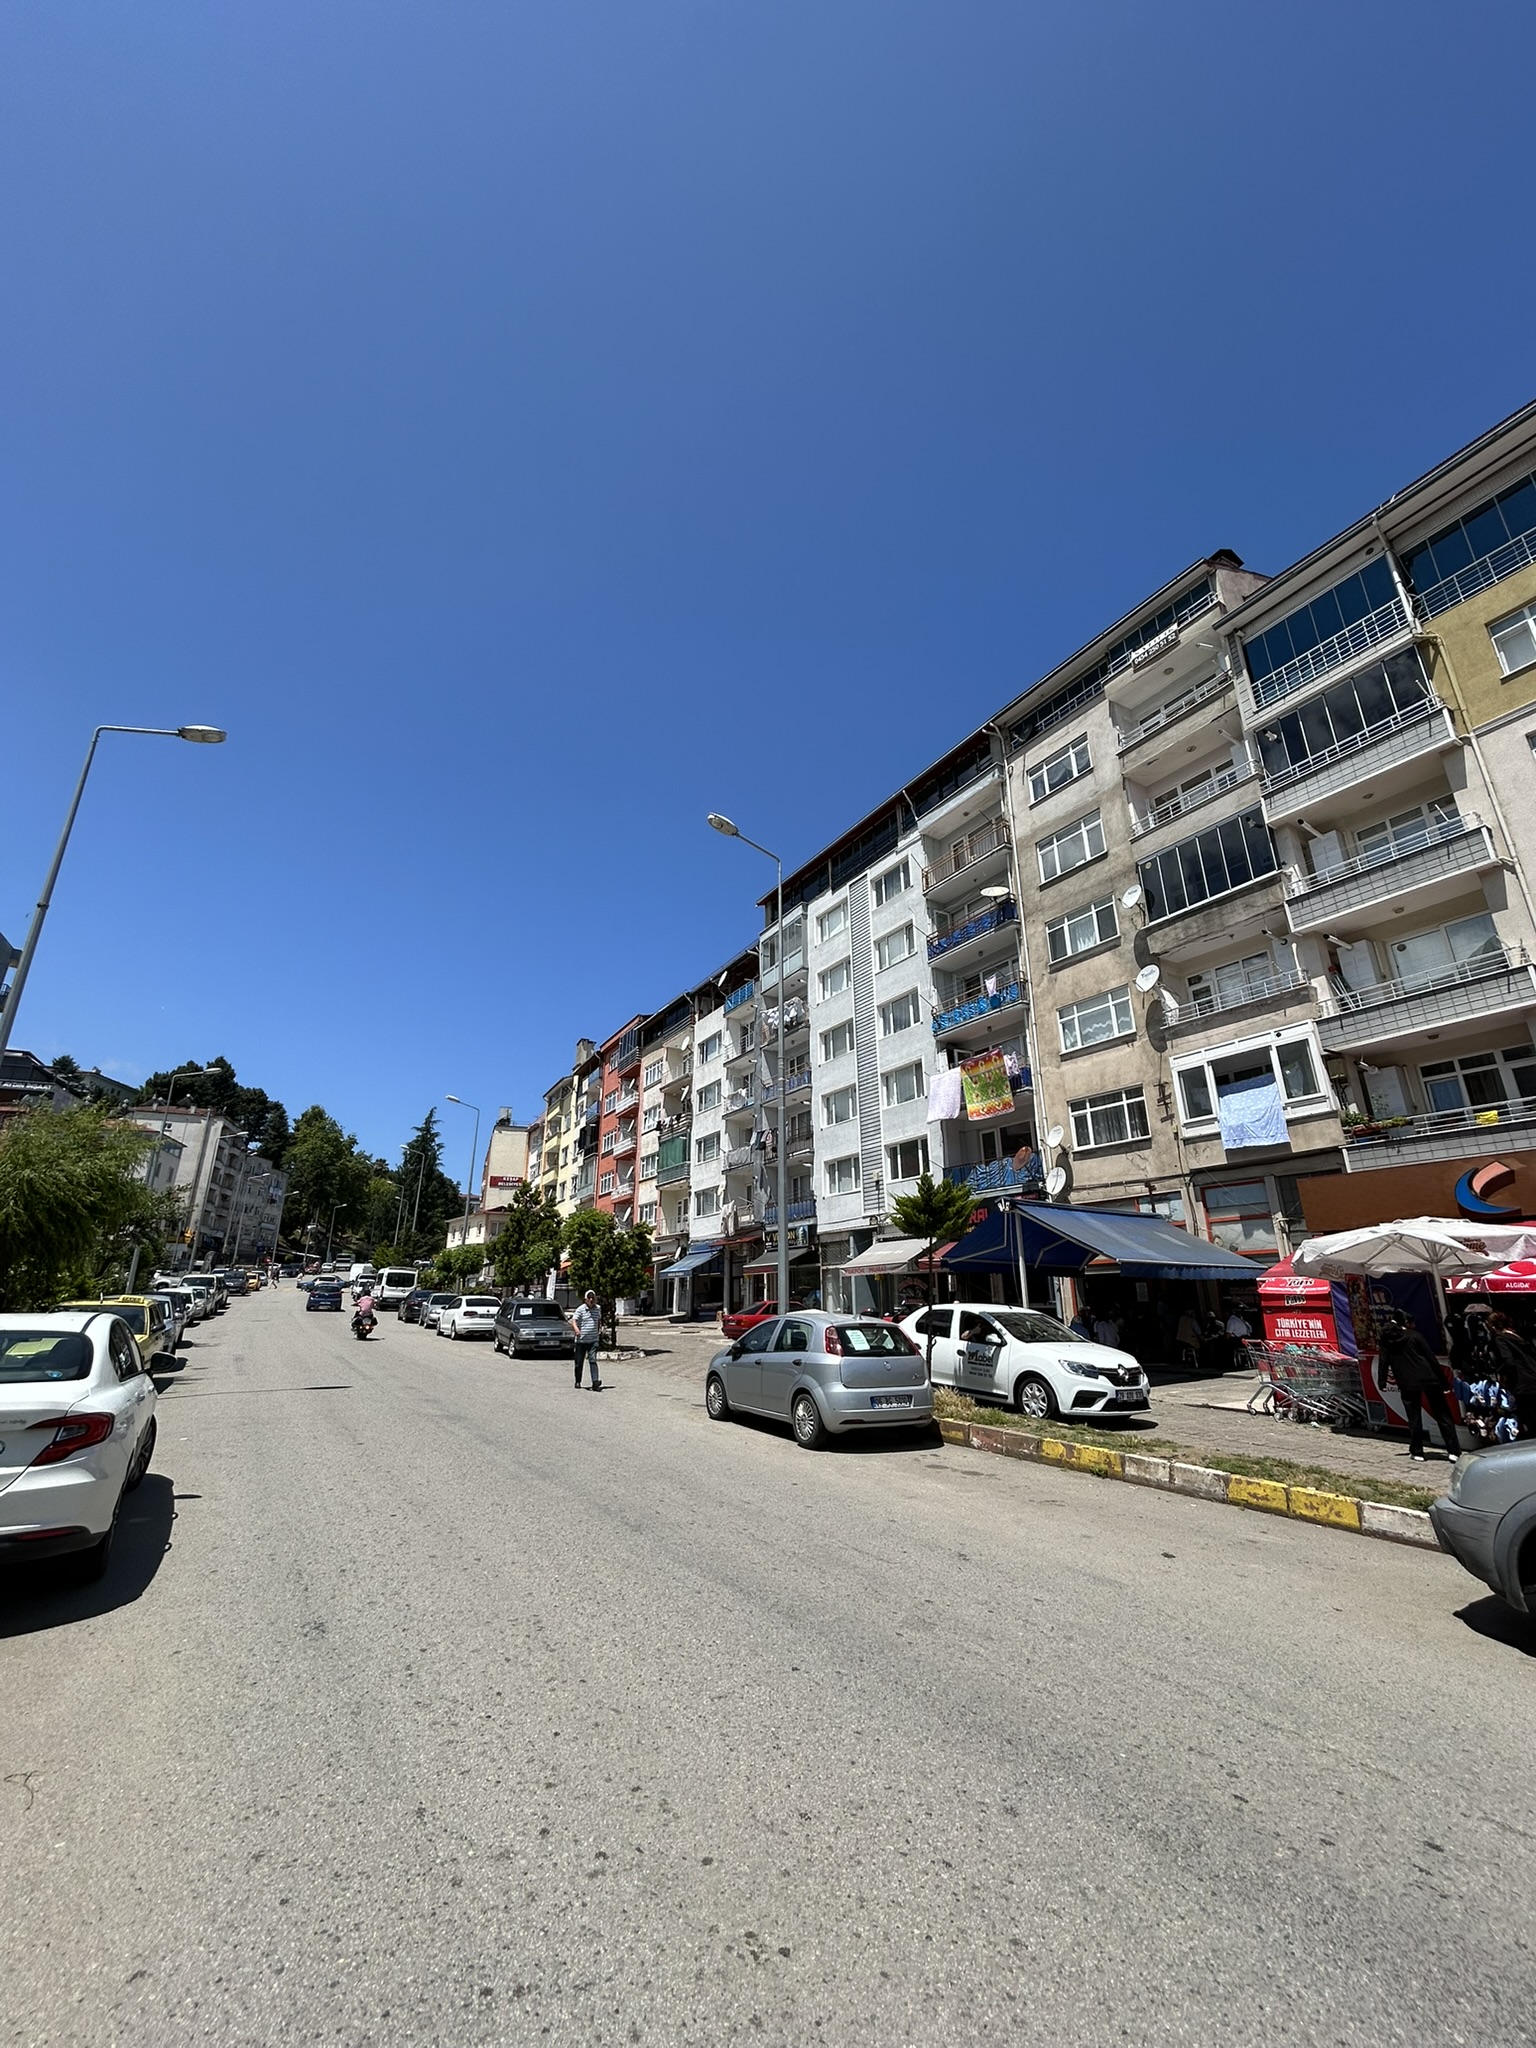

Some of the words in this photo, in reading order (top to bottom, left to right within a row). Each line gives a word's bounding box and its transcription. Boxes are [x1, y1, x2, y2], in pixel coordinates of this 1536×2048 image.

[1160, 638, 1167, 648] 51
[1276, 1318, 1322, 1329] TÜRKİYE'NİN
[1292, 1329, 1327, 1339] LEZZETLERİ
